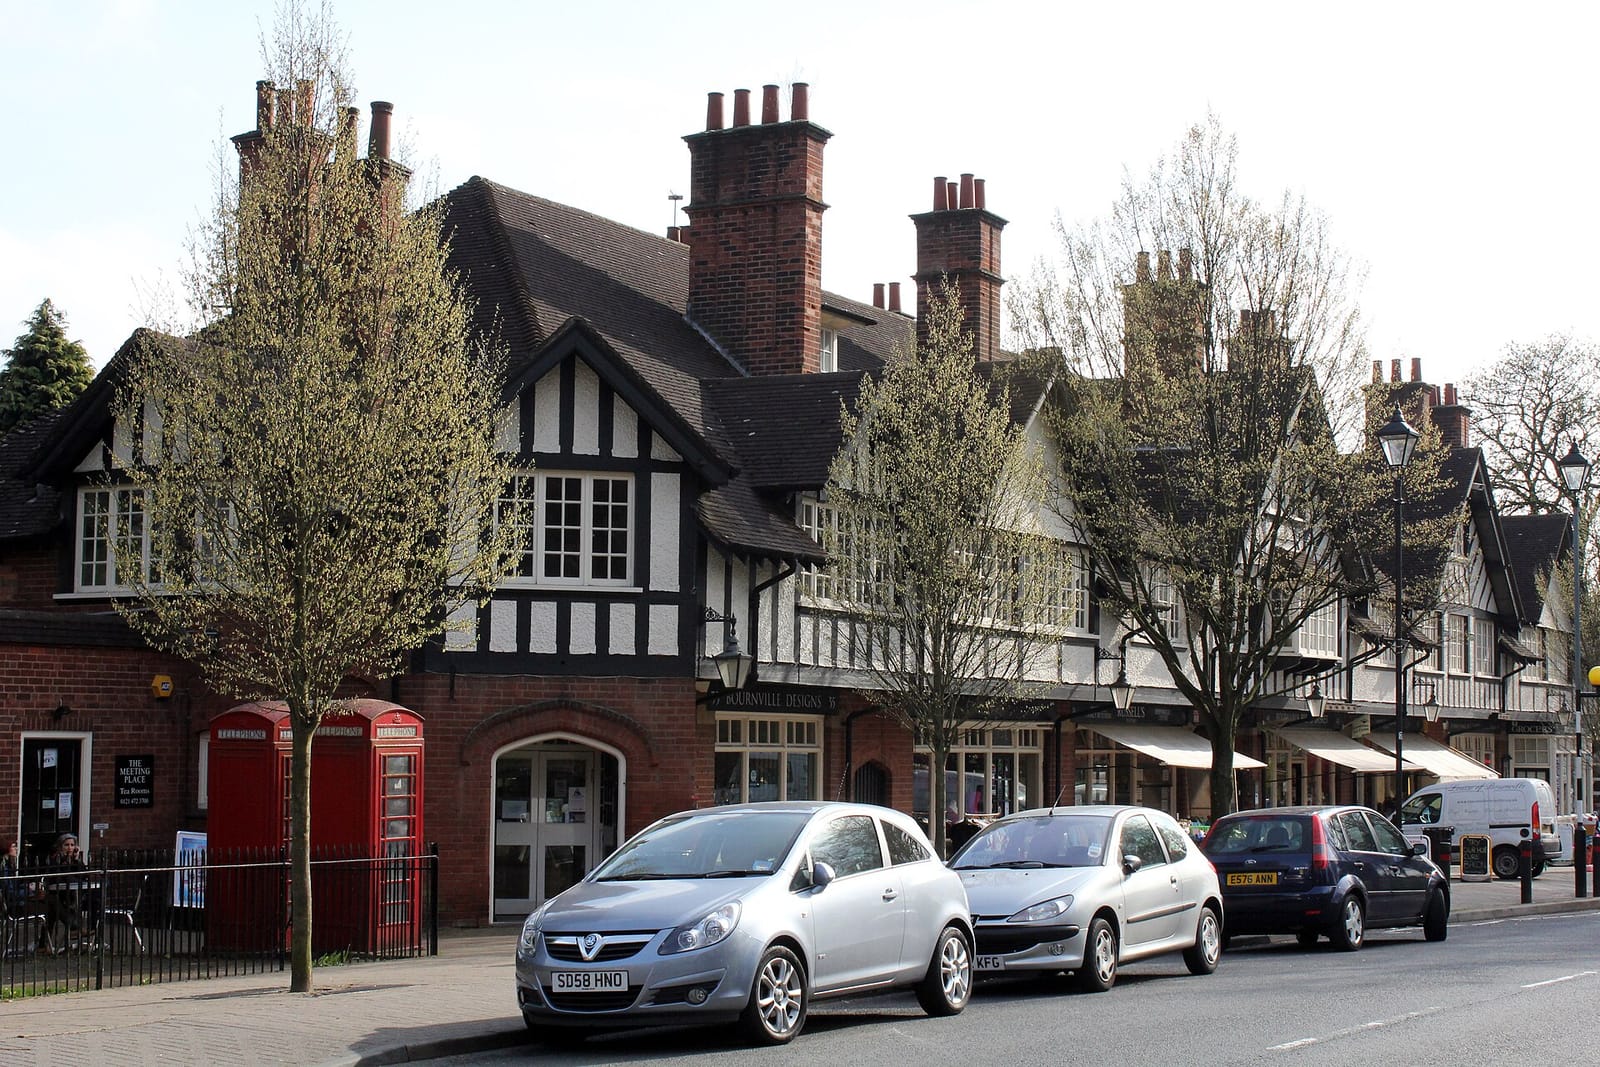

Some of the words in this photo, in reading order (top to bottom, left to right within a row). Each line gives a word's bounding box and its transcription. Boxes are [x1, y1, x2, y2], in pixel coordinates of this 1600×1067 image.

[726, 691, 780, 707] BOURNVILLE
[786, 694, 821, 708] DESIGNS
[219, 729, 265, 738] TELEPHONE
[378, 727, 416, 737] TELEPHONE
[1231, 874, 1253, 884] E576
[1255, 874, 1273, 883] ANN
[977, 956, 999, 968] KFG
[558, 973, 590, 987] SD58
[594, 973, 622, 987] HNO
